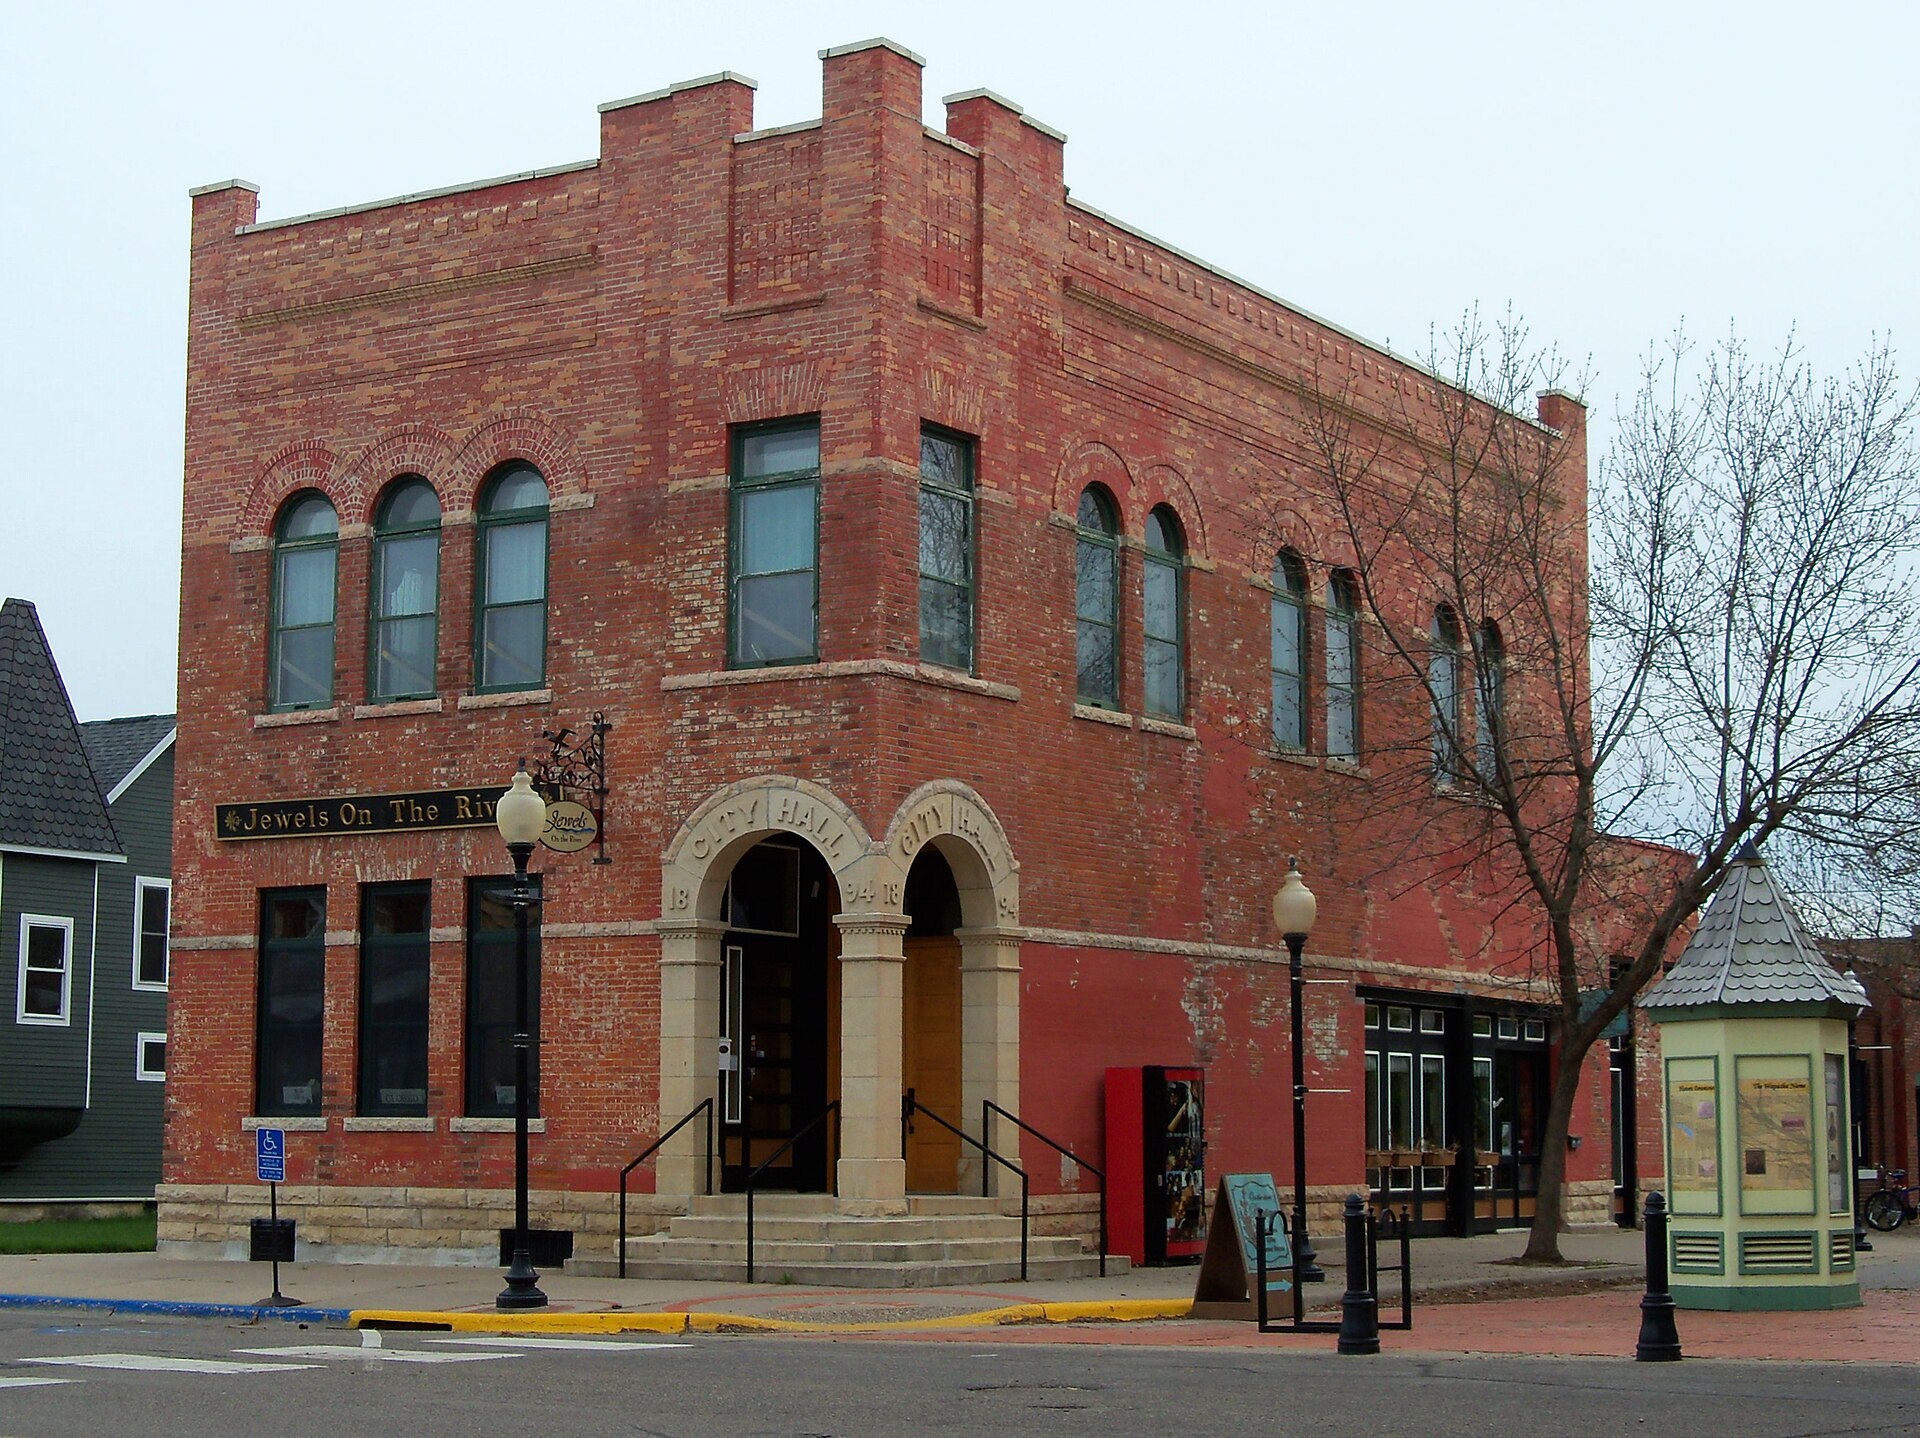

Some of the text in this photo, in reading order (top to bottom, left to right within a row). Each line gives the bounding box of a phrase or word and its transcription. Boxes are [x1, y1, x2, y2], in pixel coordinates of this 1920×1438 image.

[244, 794, 497, 831] Jewels On The Riv
[543, 810, 588, 832] Jewels
[691, 798, 844, 860] CITY HALL
[901, 803, 1002, 871] CITY HALL
[669, 880, 876, 911] 18 94
[884, 882, 899, 906] 18
